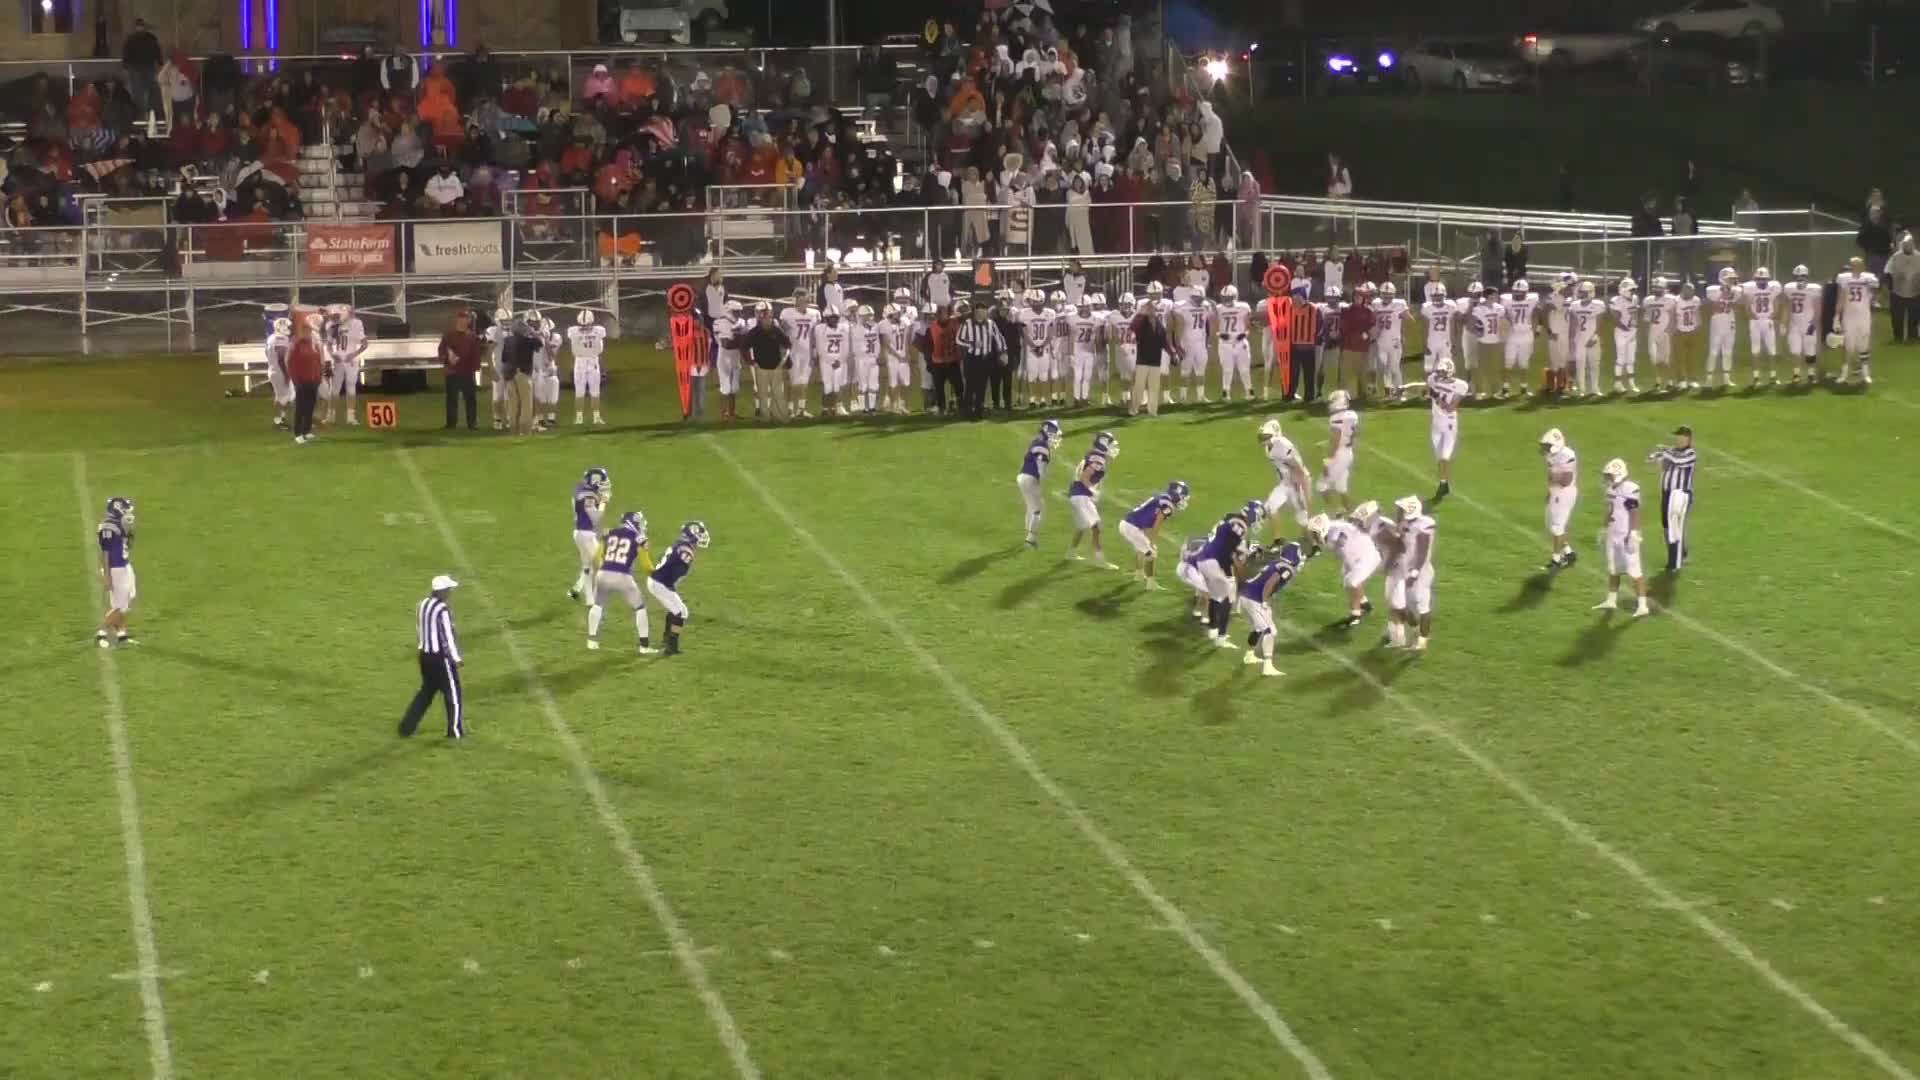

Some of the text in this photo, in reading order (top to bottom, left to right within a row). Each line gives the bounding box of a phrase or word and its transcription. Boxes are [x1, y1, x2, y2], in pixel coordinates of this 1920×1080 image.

[1224, 316, 1238, 332] 72
[1514, 308, 1525, 324] 71
[370, 405, 394, 426] 50
[606, 536, 631, 565] 22
